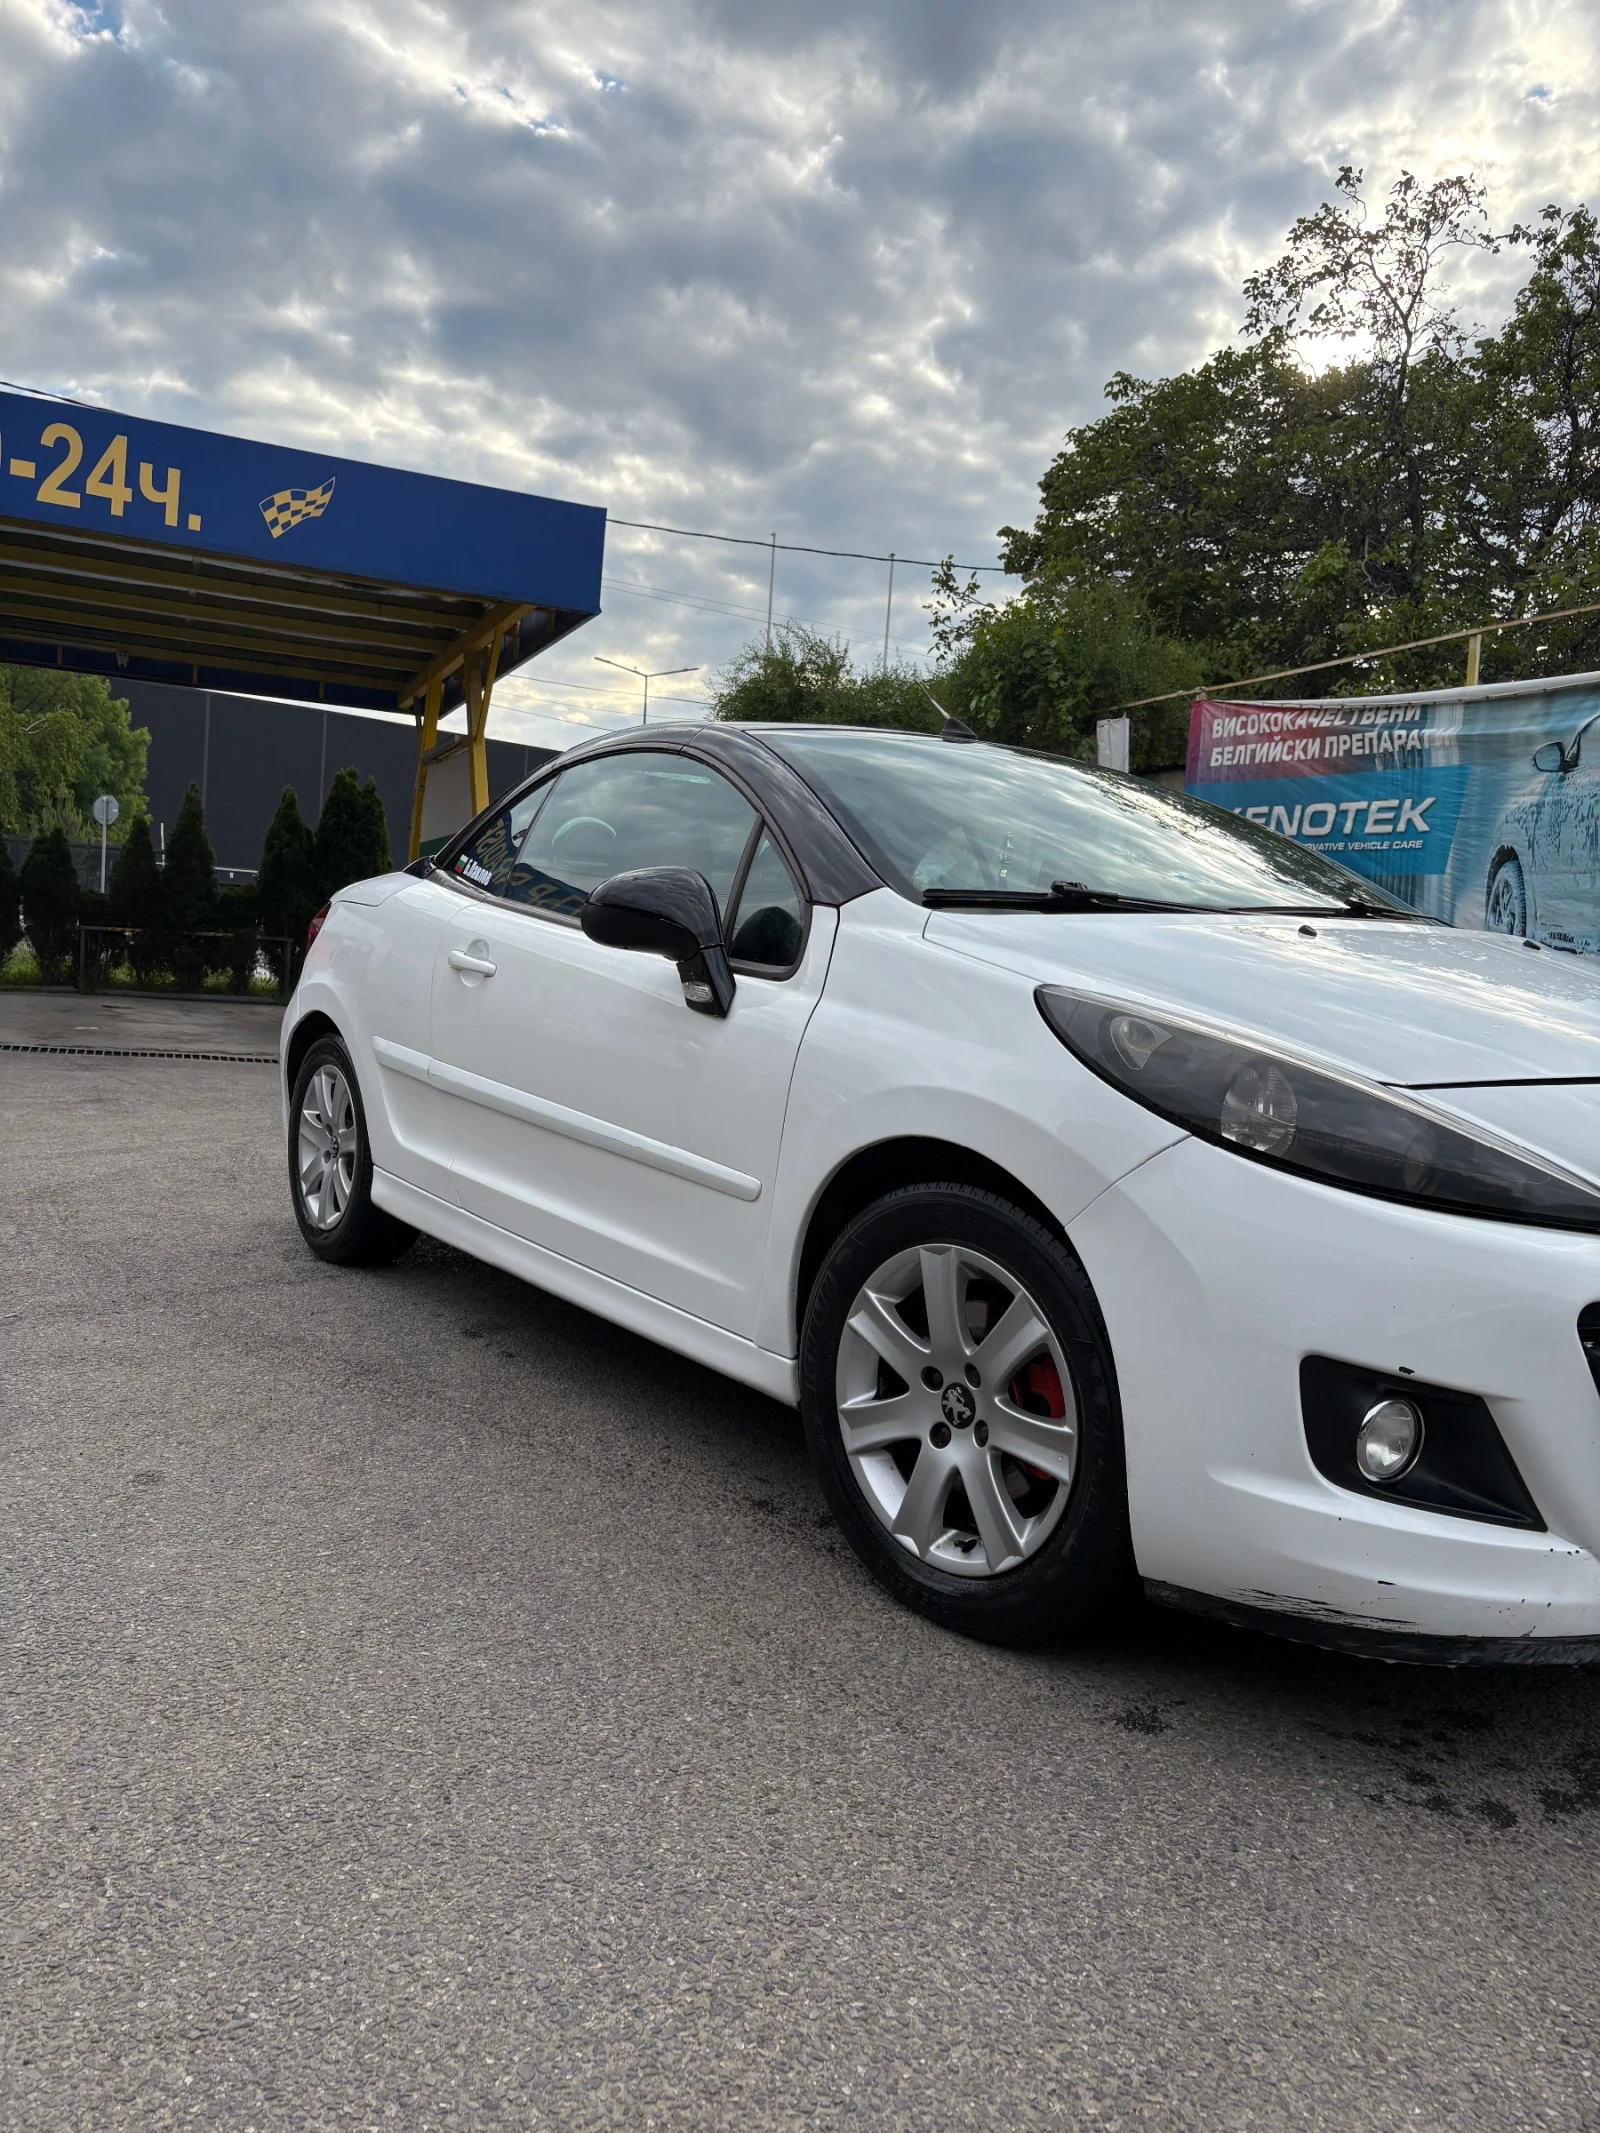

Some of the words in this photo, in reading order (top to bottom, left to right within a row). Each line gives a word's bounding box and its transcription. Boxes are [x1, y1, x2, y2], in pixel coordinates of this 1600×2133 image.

[0, 422, 202, 532] -24ч.
[1212, 705, 1421, 739] ВИСОКОКАЧЕСТВЕНИ
[1210, 735, 1321, 767] БЕЛГИЙСКИ
[1232, 797, 1436, 836] ENOTEK
[1348, 841, 1390, 850] VEHICLE
[1392, 840, 1424, 849] CARE
